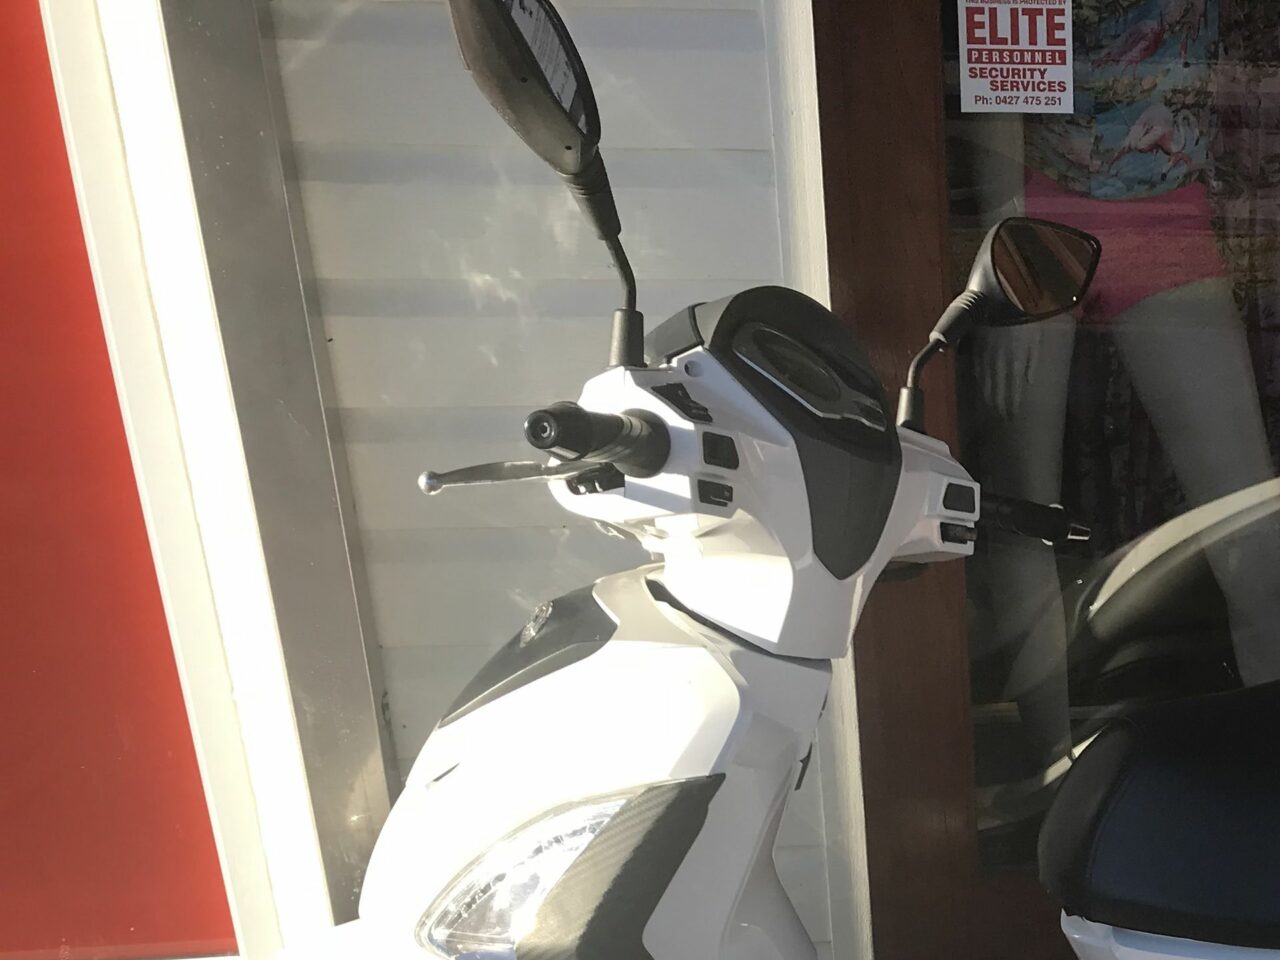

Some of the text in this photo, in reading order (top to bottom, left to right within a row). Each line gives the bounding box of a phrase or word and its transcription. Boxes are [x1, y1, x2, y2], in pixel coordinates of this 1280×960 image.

[965, 7, 1067, 46] ELITE
[971, 50, 1062, 64] PERSONNEL
[968, 67, 1048, 80] SECURITY
[989, 80, 1067, 92] SERVICES
[974, 95, 1062, 106] Ph: 0427 475 251
